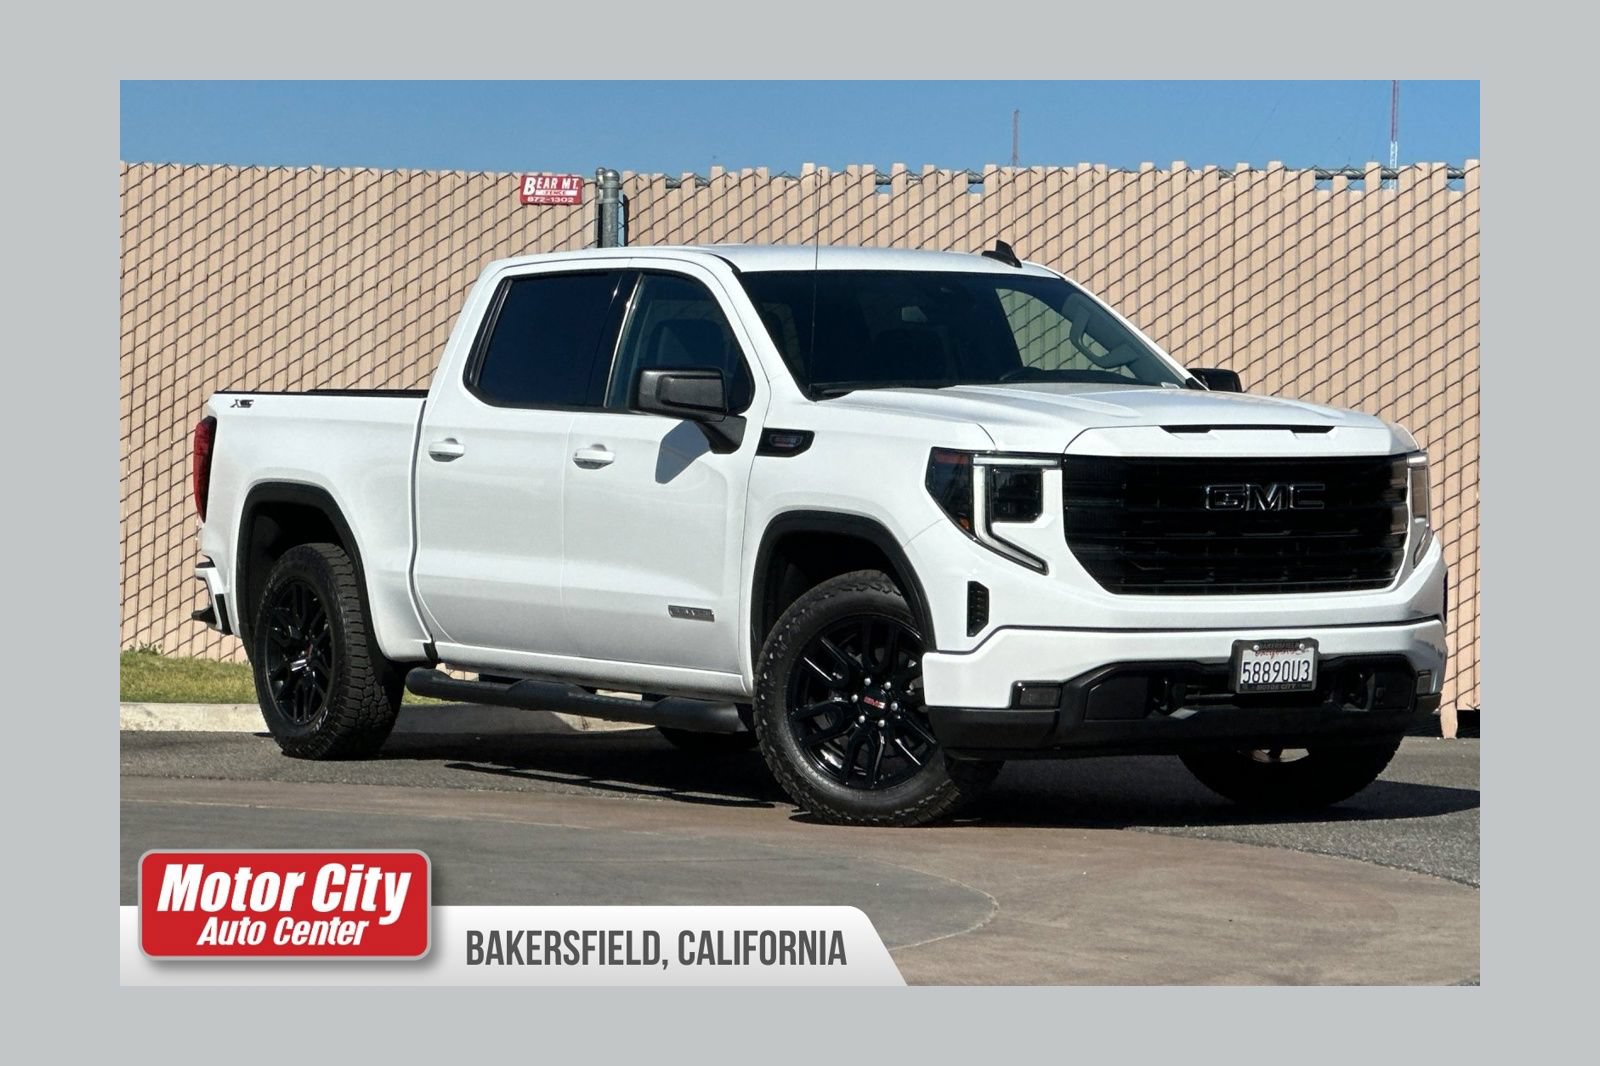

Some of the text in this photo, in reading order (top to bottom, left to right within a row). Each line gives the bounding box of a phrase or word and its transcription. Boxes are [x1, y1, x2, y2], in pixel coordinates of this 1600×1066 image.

[523, 177, 579, 195] BEAR MT.
[1205, 484, 1326, 511] GMC
[1243, 660, 1310, 684] 58890U3
